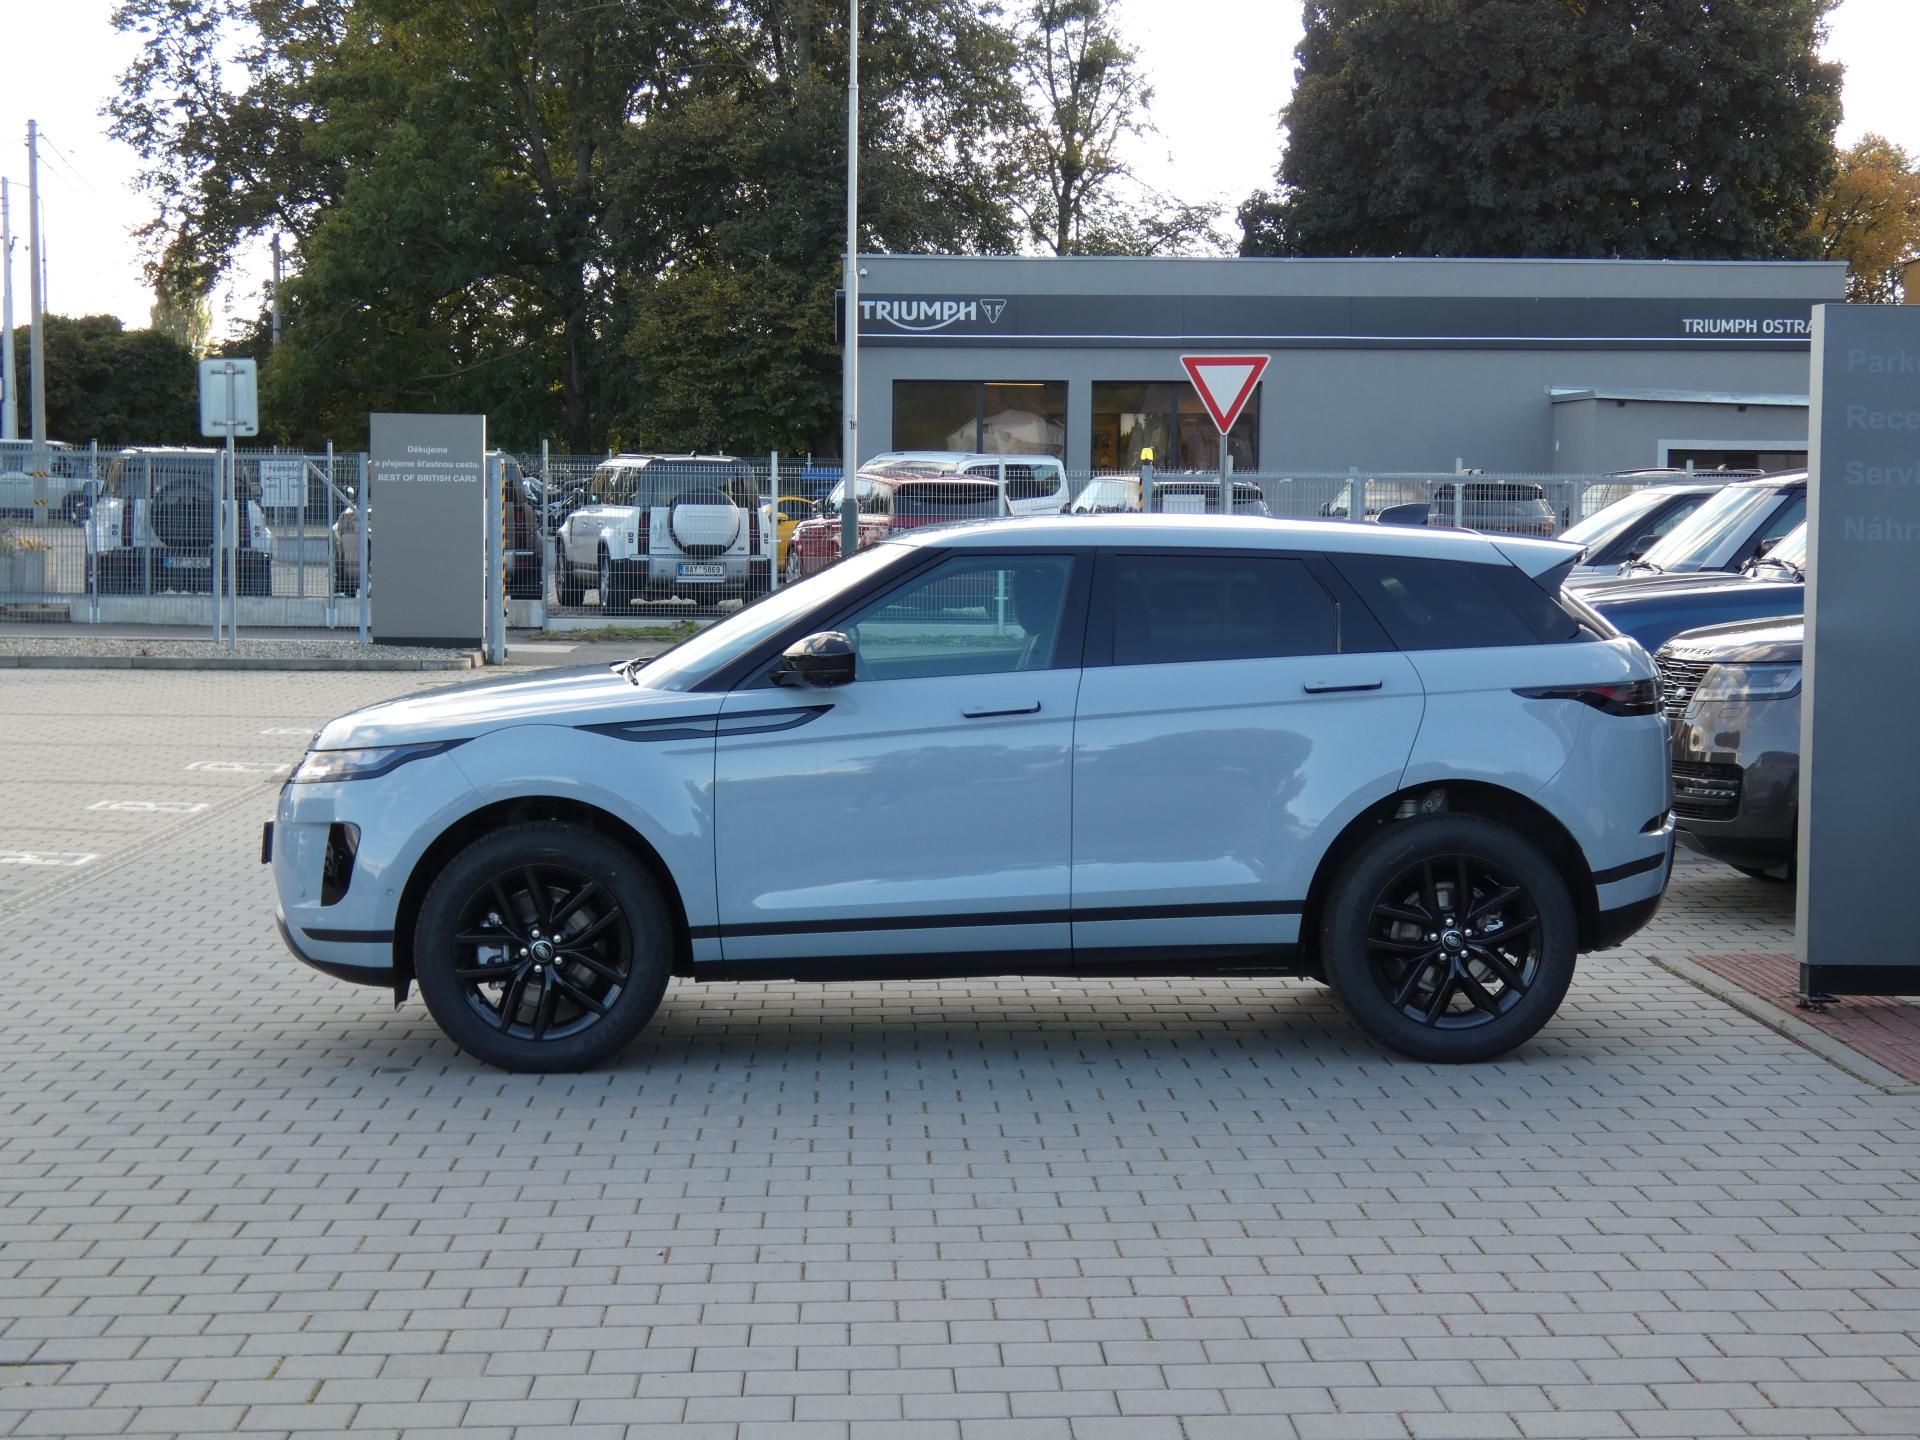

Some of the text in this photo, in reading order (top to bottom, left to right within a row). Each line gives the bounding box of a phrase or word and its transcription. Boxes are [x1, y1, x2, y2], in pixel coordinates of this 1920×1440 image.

[859, 300, 977, 330] TRIUMPH
[1682, 318, 1757, 334] TRIUMPH
[1847, 348, 1920, 373] Park
[407, 445, 448, 456] Děkujeme
[382, 459, 415, 469] přejeme
[378, 473, 477, 483] BEST OF BRITISH CARS
[1842, 515, 1920, 542] Náhr
